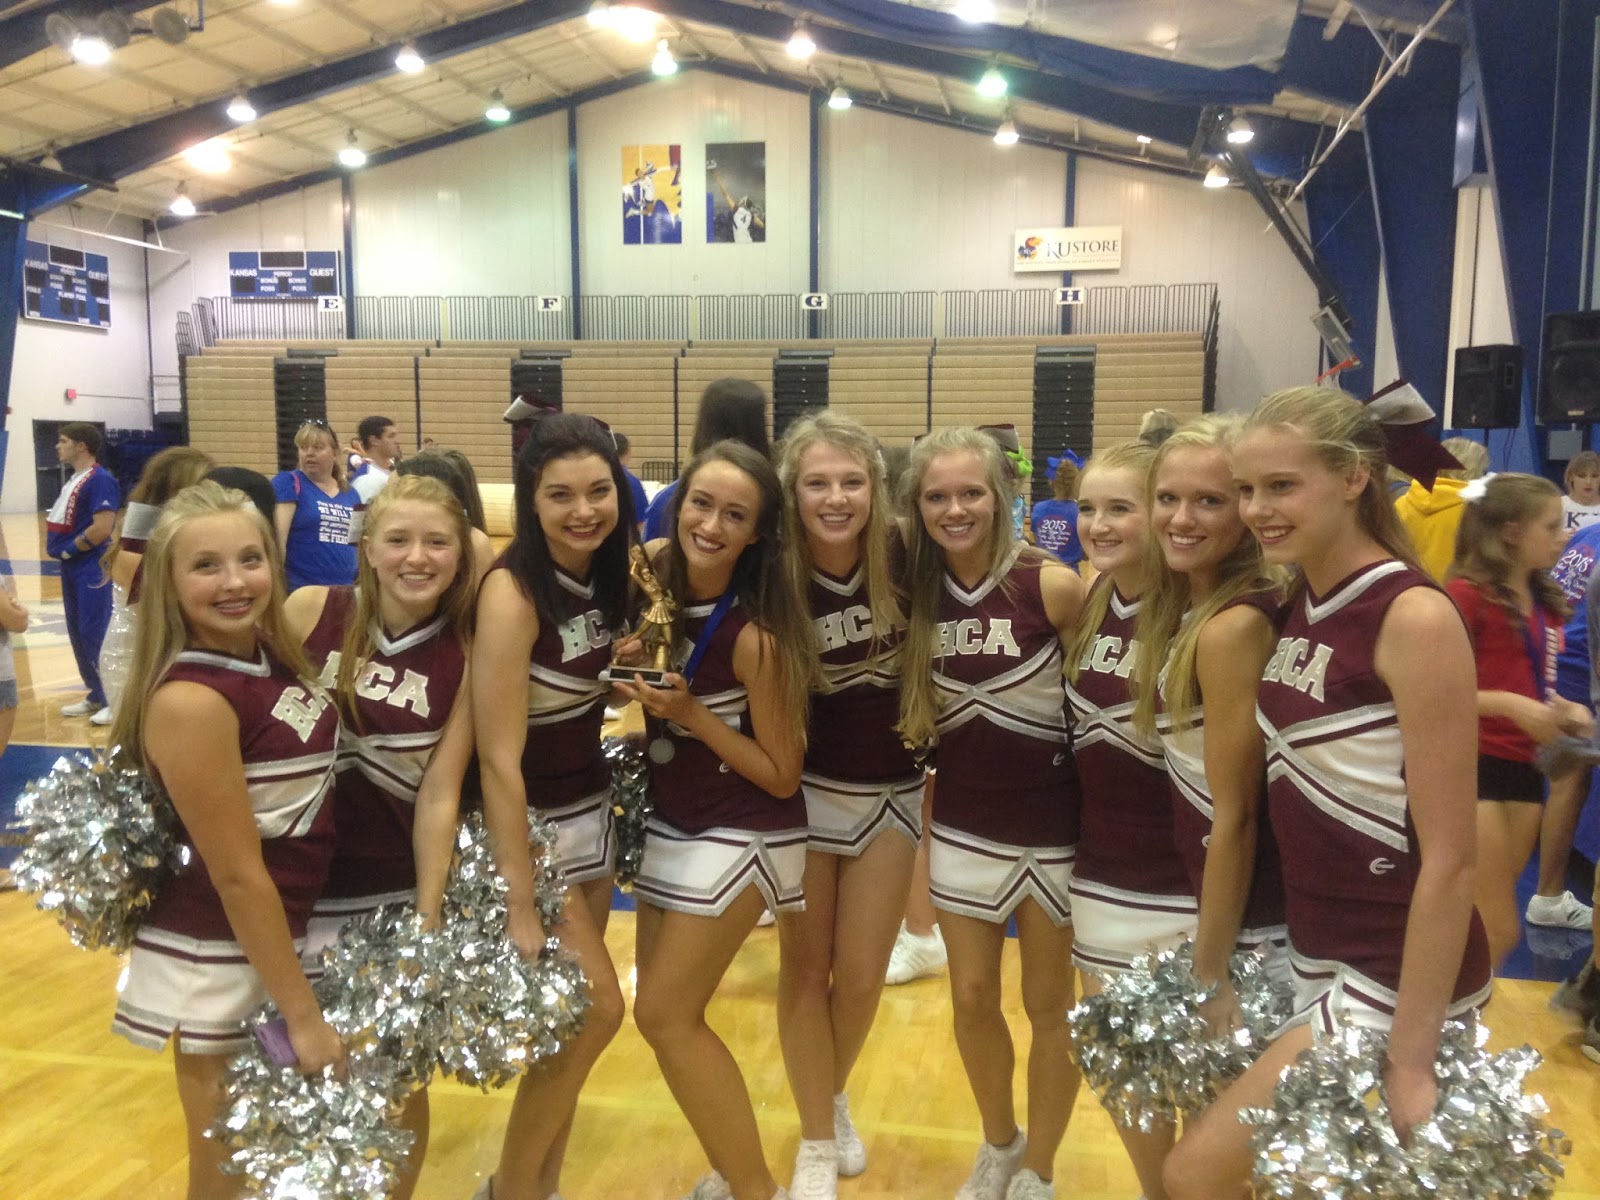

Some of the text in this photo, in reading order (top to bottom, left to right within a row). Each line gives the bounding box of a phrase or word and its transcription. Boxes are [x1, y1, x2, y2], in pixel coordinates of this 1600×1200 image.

[88, 270, 109, 281] GUEST
[230, 268, 258, 277] KANSAS
[309, 268, 335, 277] GUEST
[805, 296, 823, 307] G
[1060, 290, 1081, 302] H
[323, 299, 338, 309] E
[542, 298, 557, 309] F
[1041, 519, 1067, 530] 2015
[1561, 549, 1594, 573] 2015
[932, 618, 1021, 657] HCA
[1261, 636, 1335, 703] HCA
